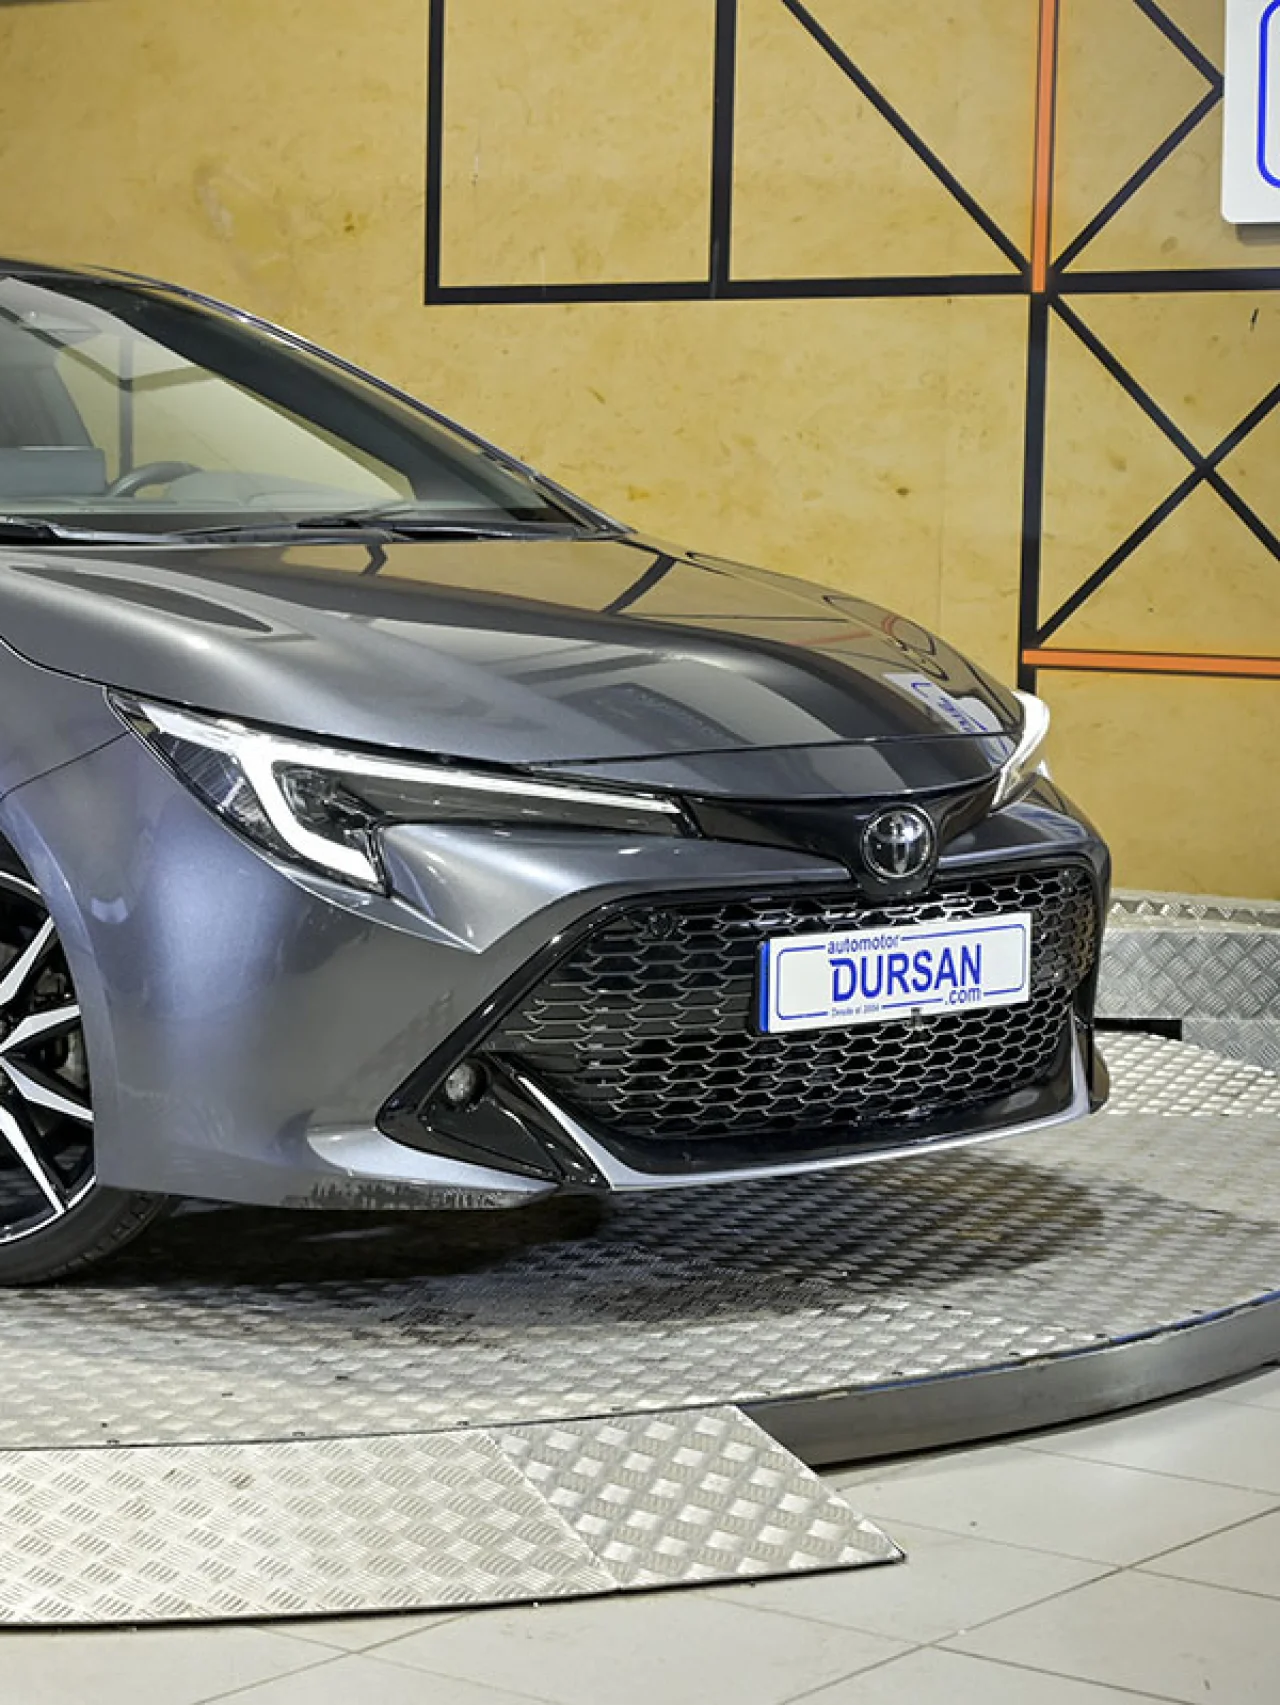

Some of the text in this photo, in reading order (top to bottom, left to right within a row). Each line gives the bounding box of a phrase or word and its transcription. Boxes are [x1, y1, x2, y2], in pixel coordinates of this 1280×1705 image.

[827, 934, 900, 954] automotor
[828, 943, 983, 1002] DURSAN
[944, 986, 982, 1005] .com
